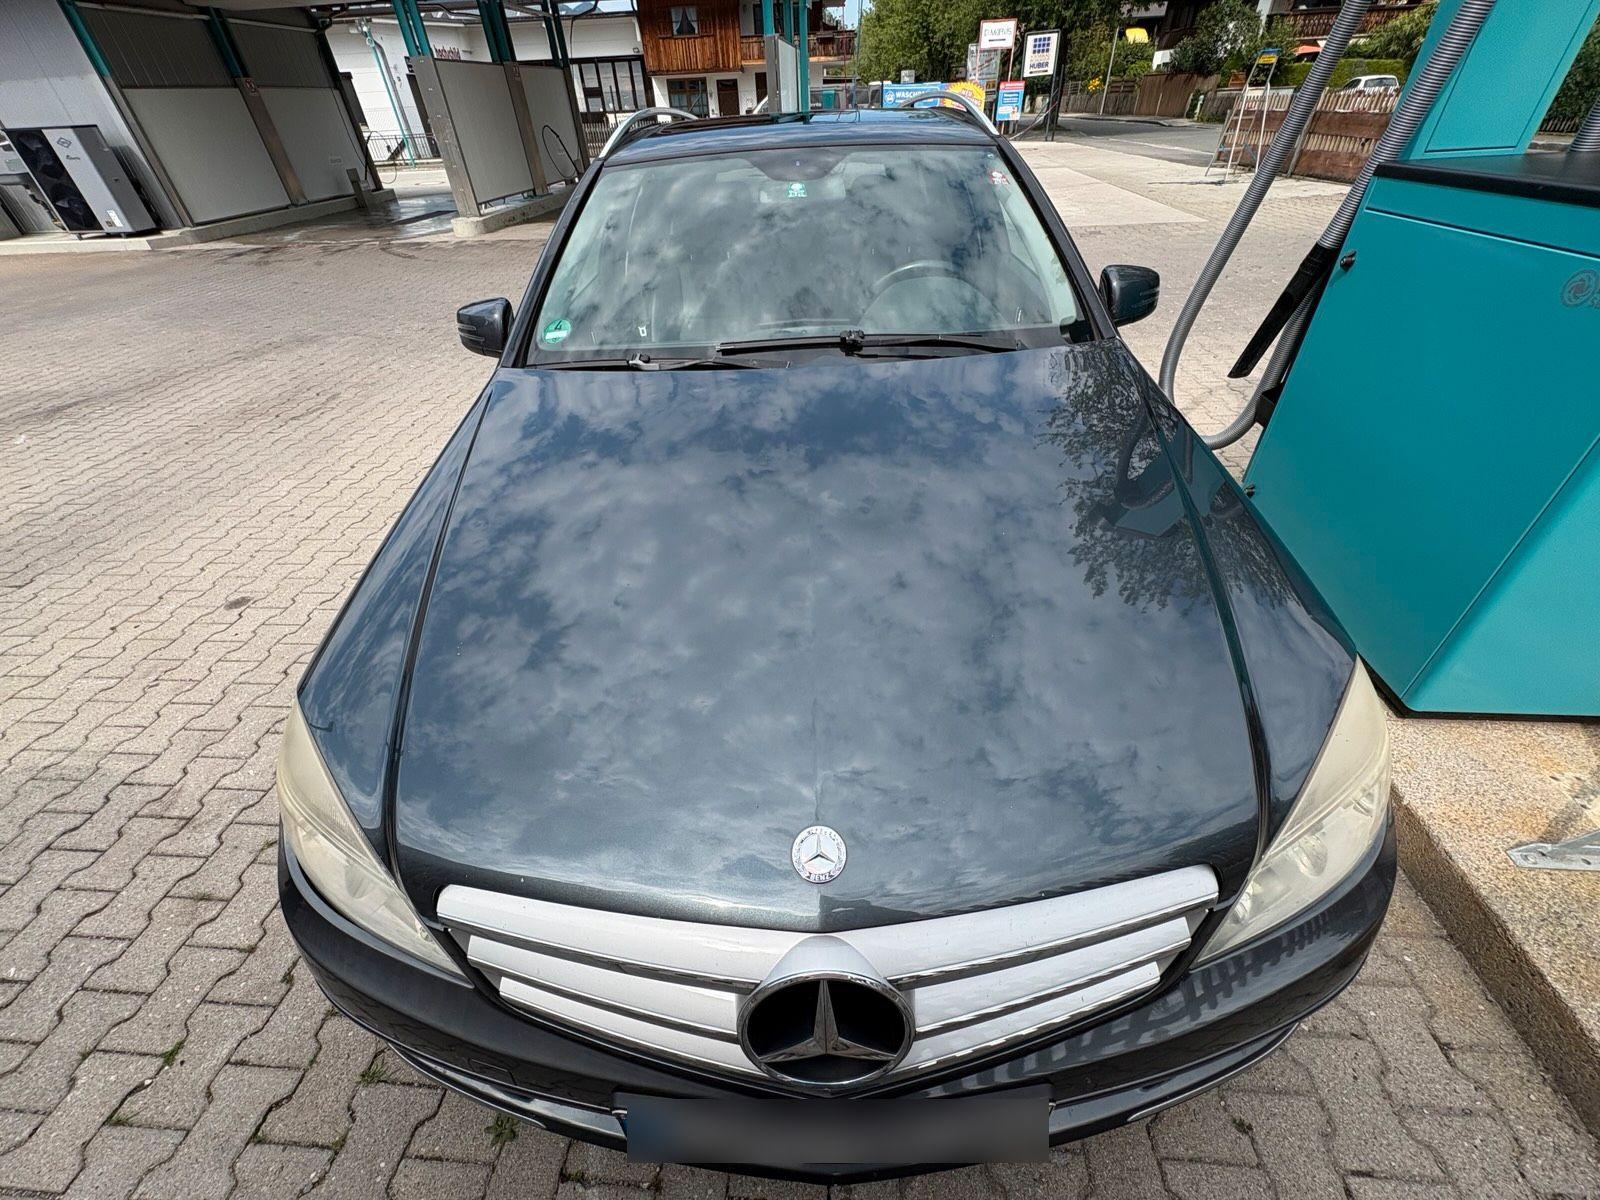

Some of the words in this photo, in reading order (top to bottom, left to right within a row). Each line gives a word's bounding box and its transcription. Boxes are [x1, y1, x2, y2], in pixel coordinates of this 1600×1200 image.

[1029, 61, 1049, 70] HUBER
[554, 320, 562, 330] 4
[810, 873, 831, 881] BENZ
